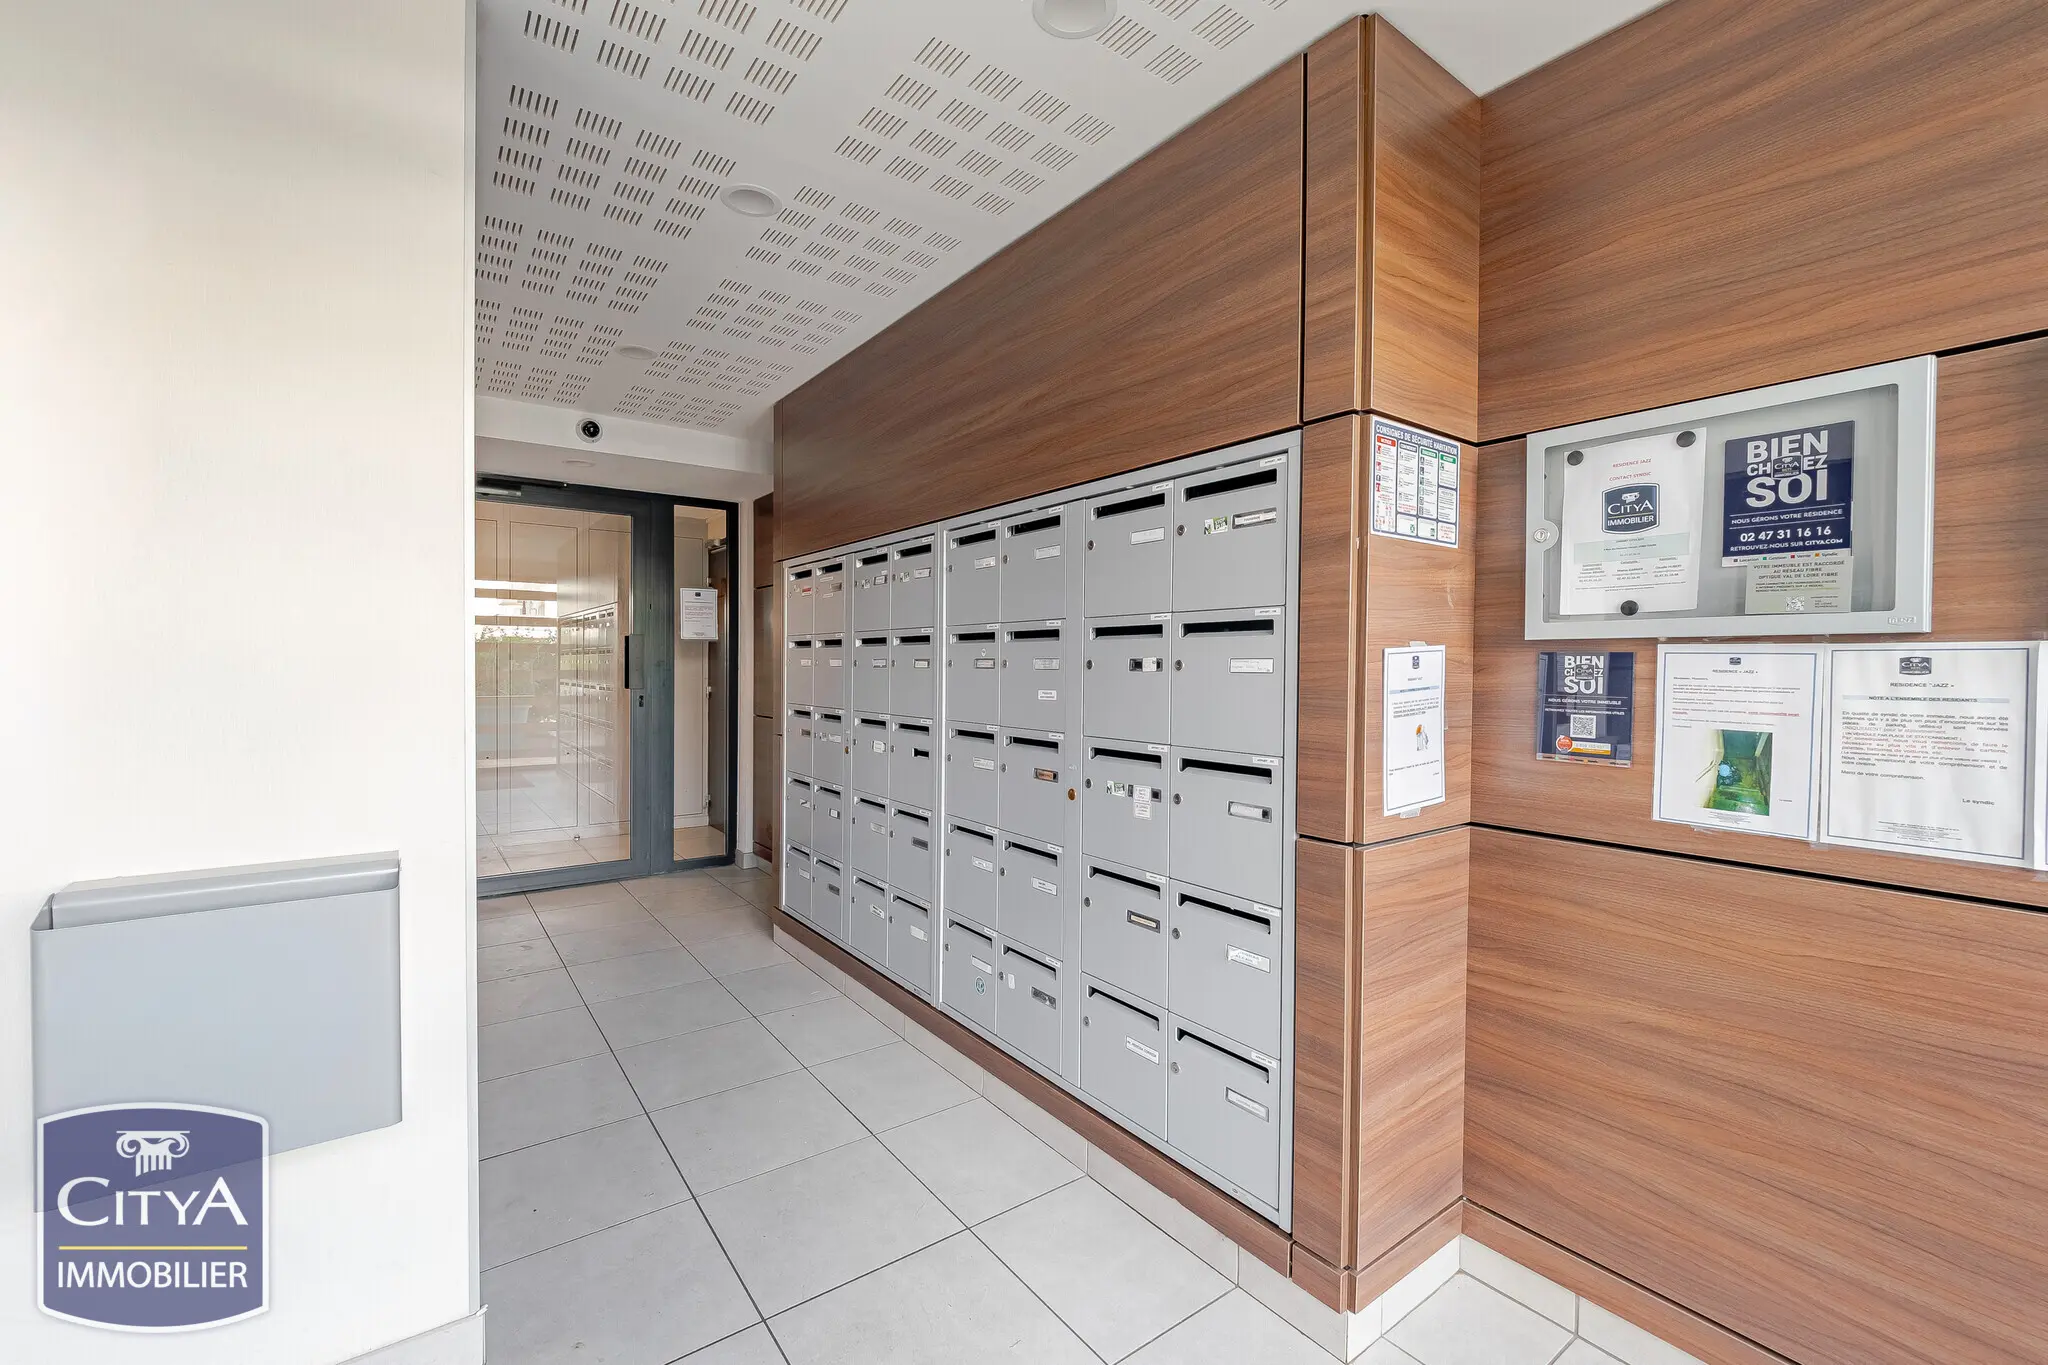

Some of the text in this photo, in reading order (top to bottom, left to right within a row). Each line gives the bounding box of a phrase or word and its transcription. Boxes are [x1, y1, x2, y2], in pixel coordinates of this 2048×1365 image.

[1746, 430, 1828, 464] BIEN
[1746, 469, 1828, 508] SOI
[1608, 500, 1654, 515] CITYA
[1608, 516, 1654, 526] IMMOBILIER
[1740, 526, 1832, 542] 02 47 31 16 16
[1564, 656, 1604, 668] BIEN
[1564, 676, 1604, 694] SOI
